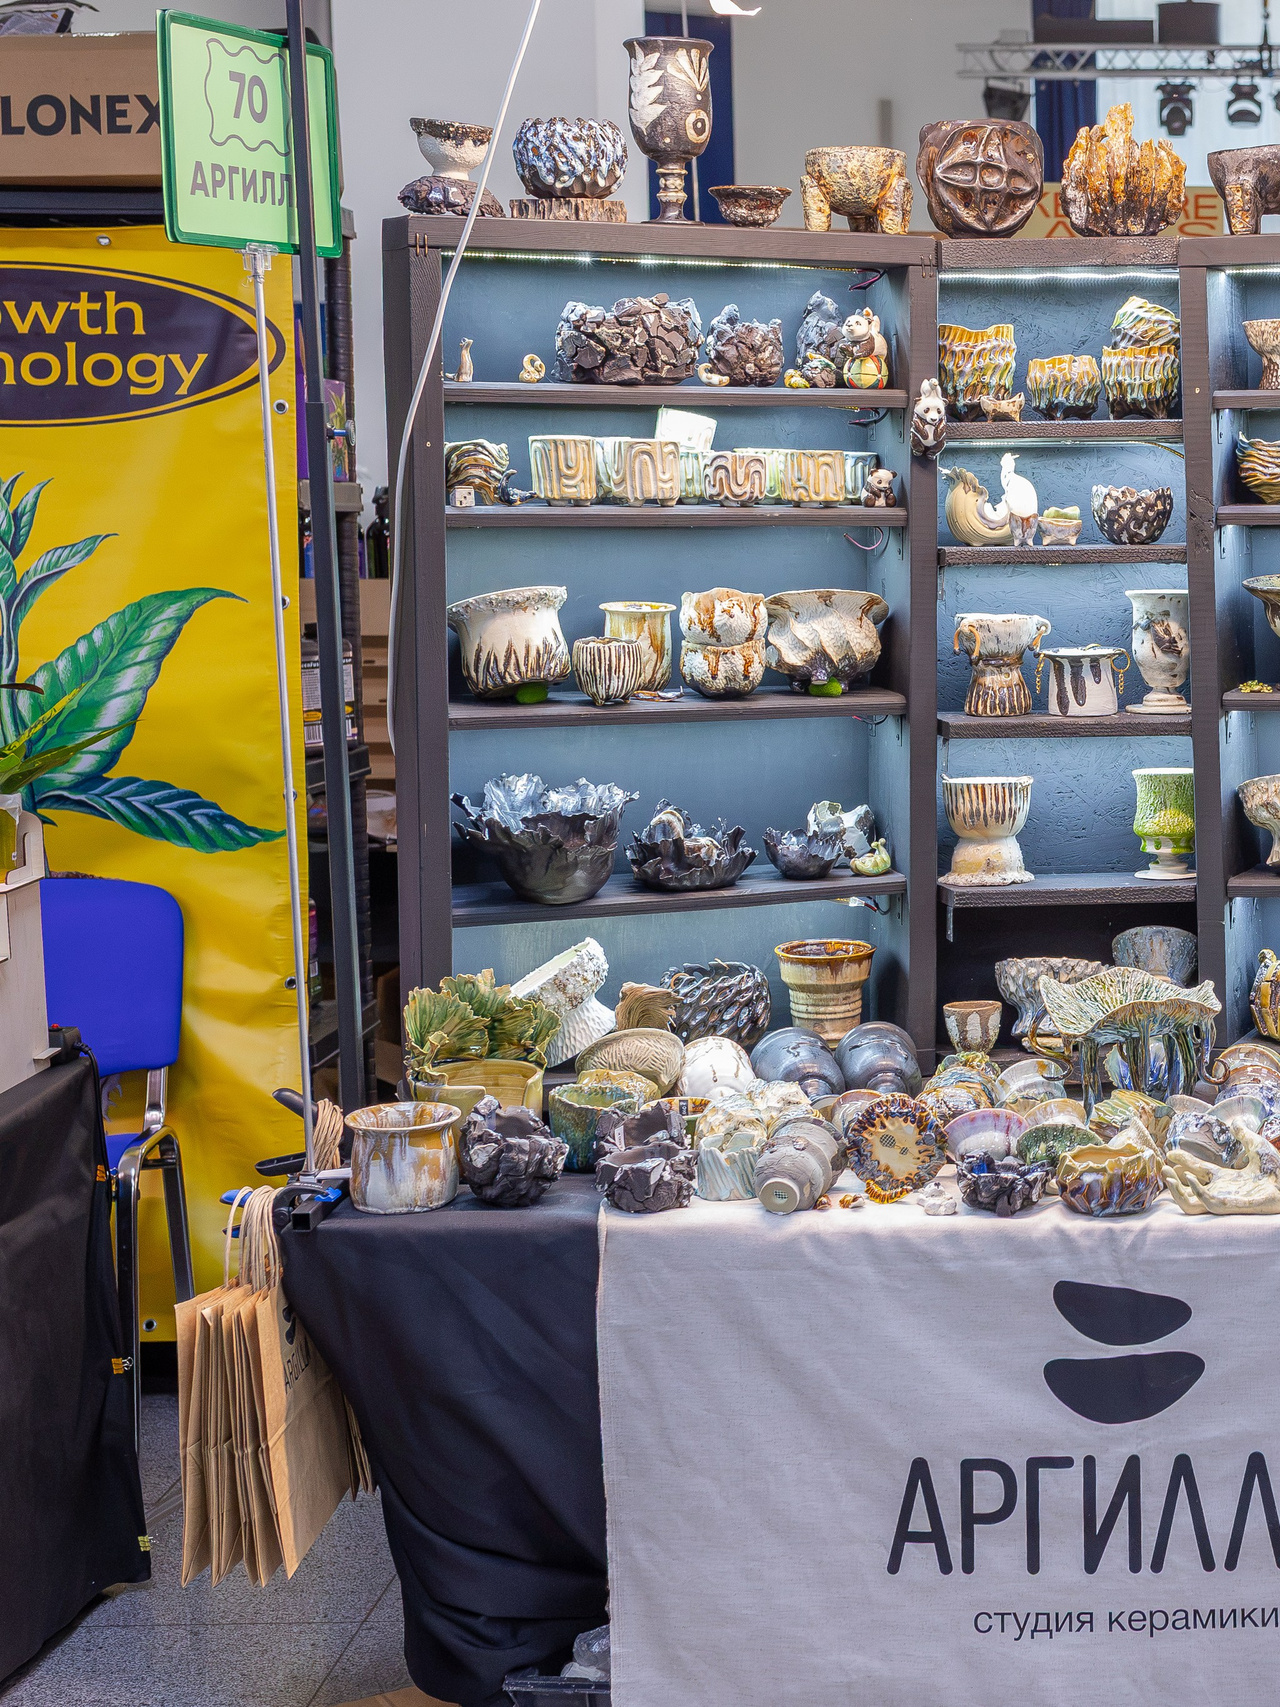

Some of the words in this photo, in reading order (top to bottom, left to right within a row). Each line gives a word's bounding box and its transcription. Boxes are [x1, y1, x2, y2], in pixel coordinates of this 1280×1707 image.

[228, 70, 268, 123] 70
[190, 160, 294, 208] АРГИЛЛ
[0, 291, 146, 335] wth
[973, 1610, 1094, 1642] студия
[1108, 1607, 1279, 1638] керамики
